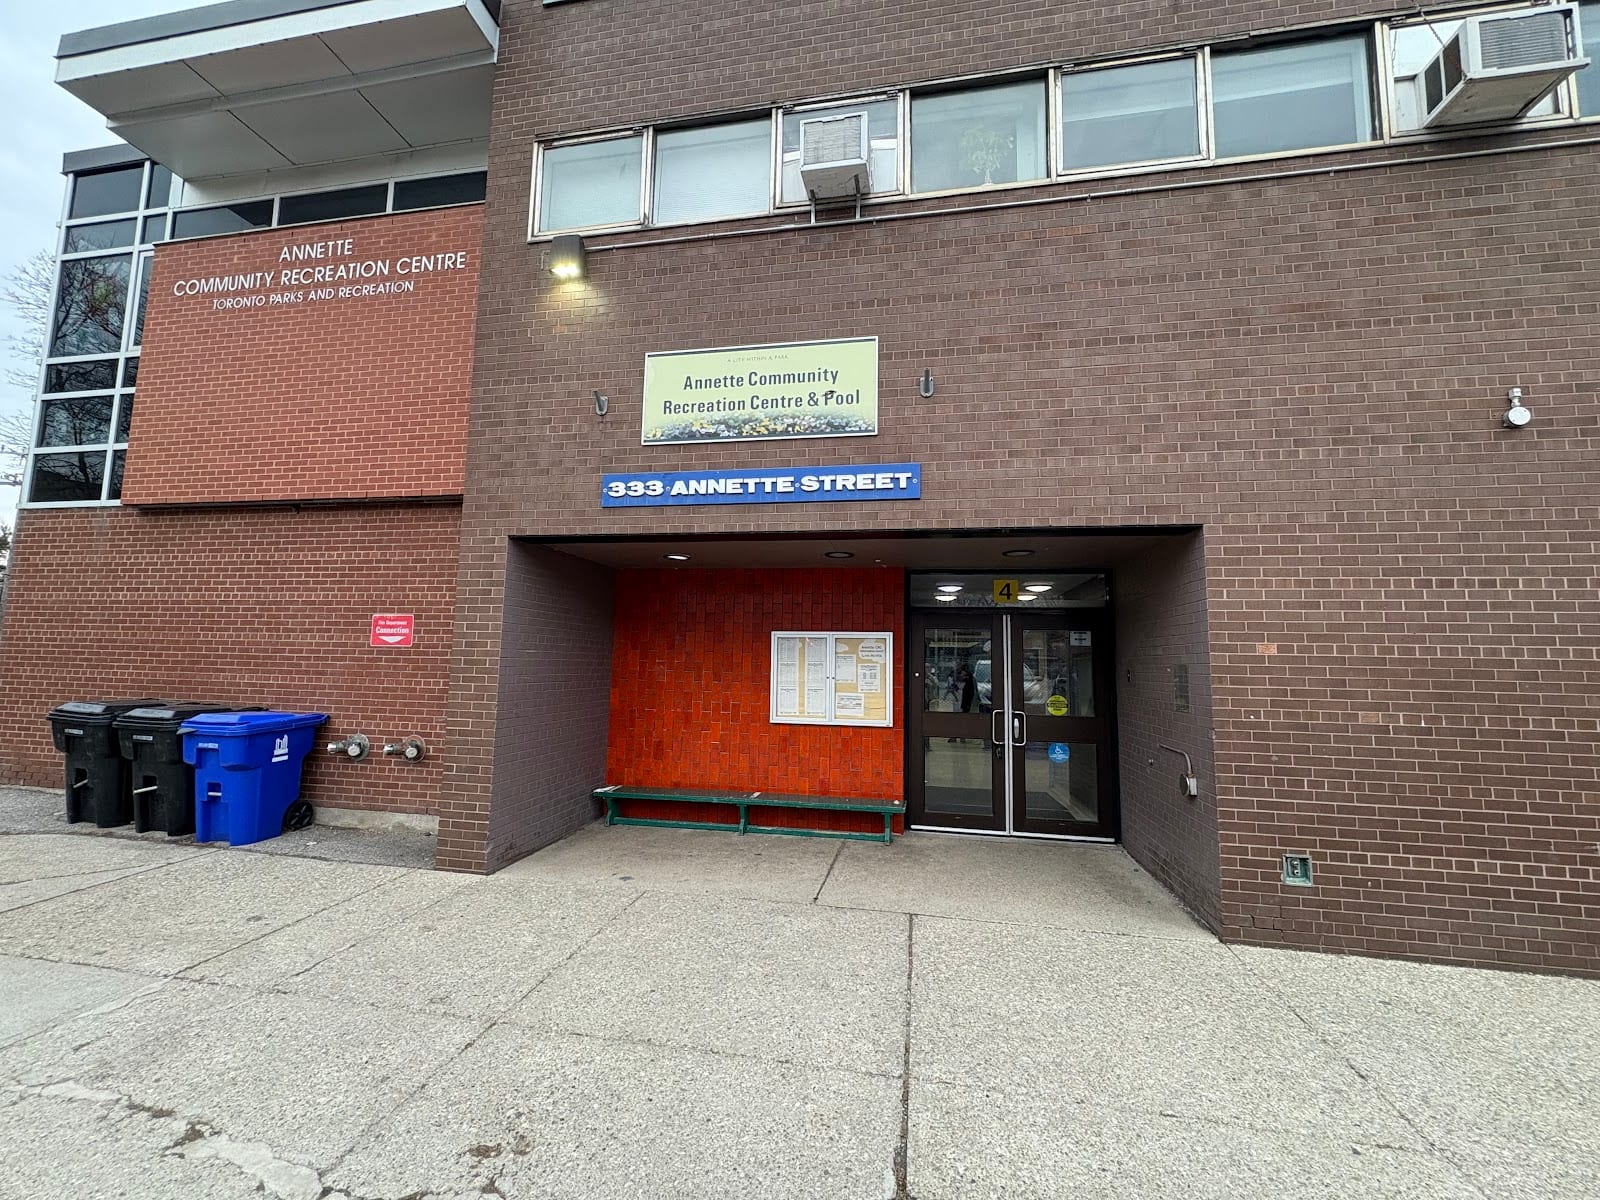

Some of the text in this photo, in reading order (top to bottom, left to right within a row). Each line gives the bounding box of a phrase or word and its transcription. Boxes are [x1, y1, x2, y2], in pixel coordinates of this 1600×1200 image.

[279, 239, 353, 262] ANNETTE
[173, 251, 467, 297] COMMUNITY RECREATION CENTRE
[213, 281, 414, 310] TORONTO PARKS AND RECREATION
[683, 367, 839, 391] Annette Community
[663, 389, 860, 415] Recreation Centre & Pool
[607, 472, 913, 498] 333 ANNETTE STREET
[998, 583, 1013, 601] 4
